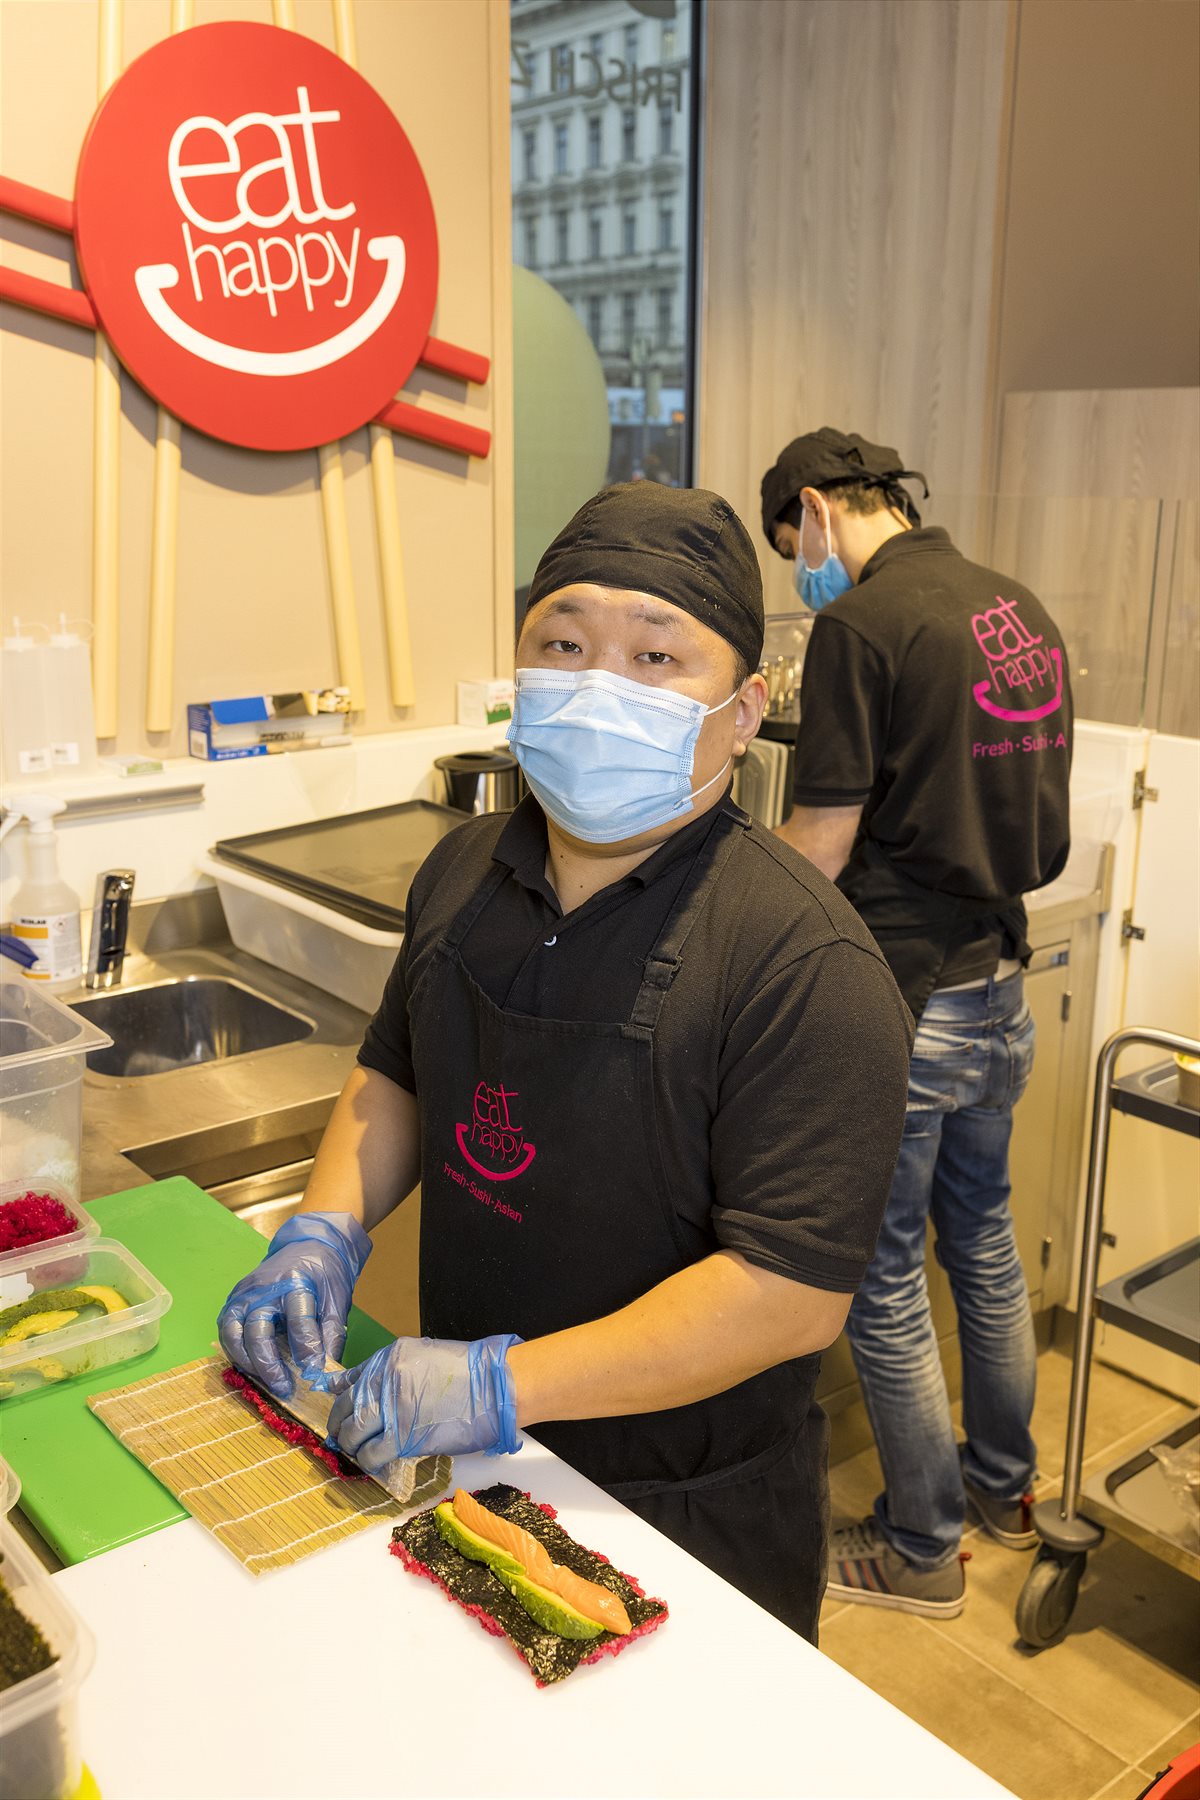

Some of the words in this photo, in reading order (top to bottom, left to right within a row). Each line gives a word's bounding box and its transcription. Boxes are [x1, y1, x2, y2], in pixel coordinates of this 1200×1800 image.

[168, 86, 356, 234] eat
[181, 222, 360, 317] happy
[971, 595, 1043, 661] eat
[986, 646, 1055, 693] happy
[972, 738, 1014, 759] Fresh
[474, 1081, 523, 1132] eat
[470, 1112, 524, 1163] happy
[443, 1161, 467, 1188] Fresh
[468, 1181, 492, 1206] Sushi
[494, 1199, 523, 1224] Asian
